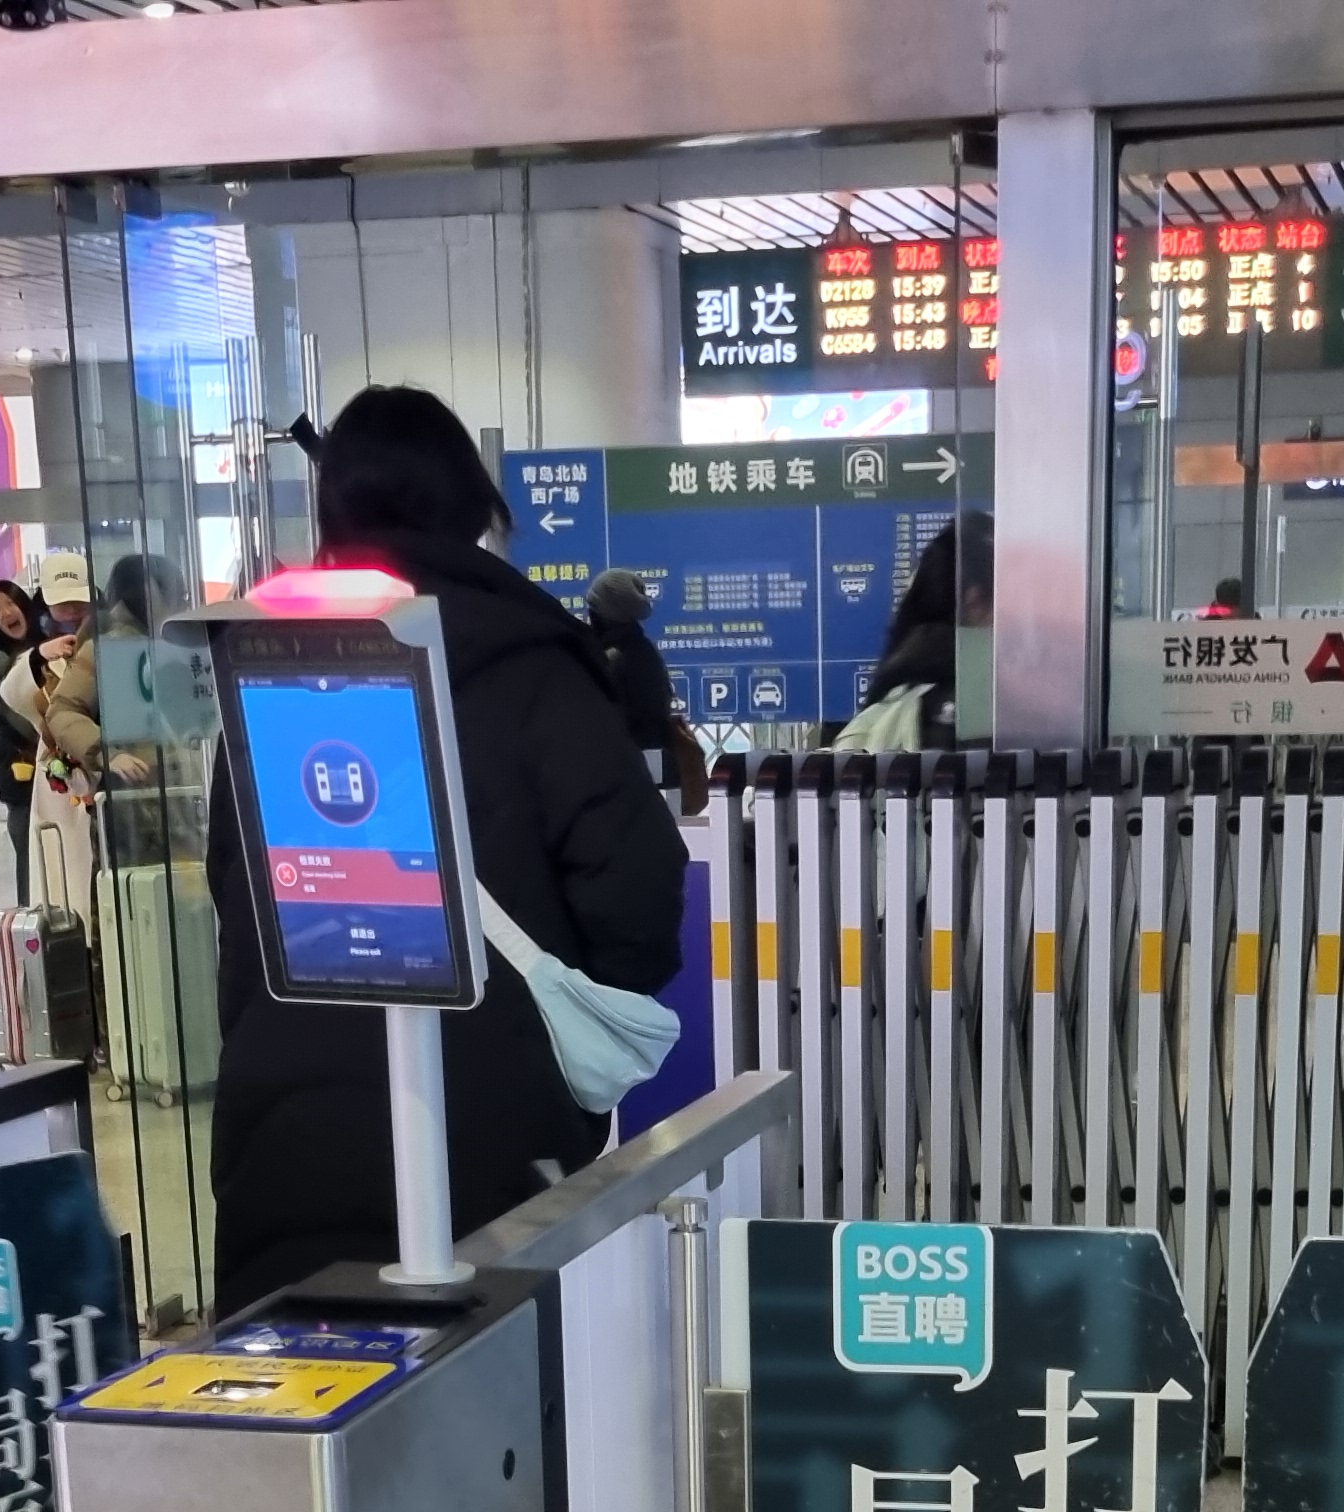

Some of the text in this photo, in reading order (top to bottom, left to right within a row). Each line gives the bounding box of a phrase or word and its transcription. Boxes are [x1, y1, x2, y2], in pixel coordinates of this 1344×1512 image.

[1160, 222, 1325, 256] 到点 状态 站台
[827, 250, 871, 276] 车次
[896, 245, 942, 270] 到点
[1150, 252, 1317, 283] 15:50 正点 4
[820, 279, 875, 302] D2128
[892, 274, 947, 298] 15:39
[1227, 281, 1276, 306] 正点
[695, 282, 798, 338] 到达
[826, 305, 870, 328] K955
[892, 301, 947, 325] 15:43
[1291, 309, 1323, 331] 10
[698, 339, 798, 366] Arrivals
[892, 328, 947, 352] 15:48
[522, 463, 587, 484] 青岛北站
[668, 457, 816, 495] 地铁乘车
[531, 486, 580, 505] 西广场
[856, 1244, 969, 1282] BOSS
[857, 1291, 969, 1346] 直聘
